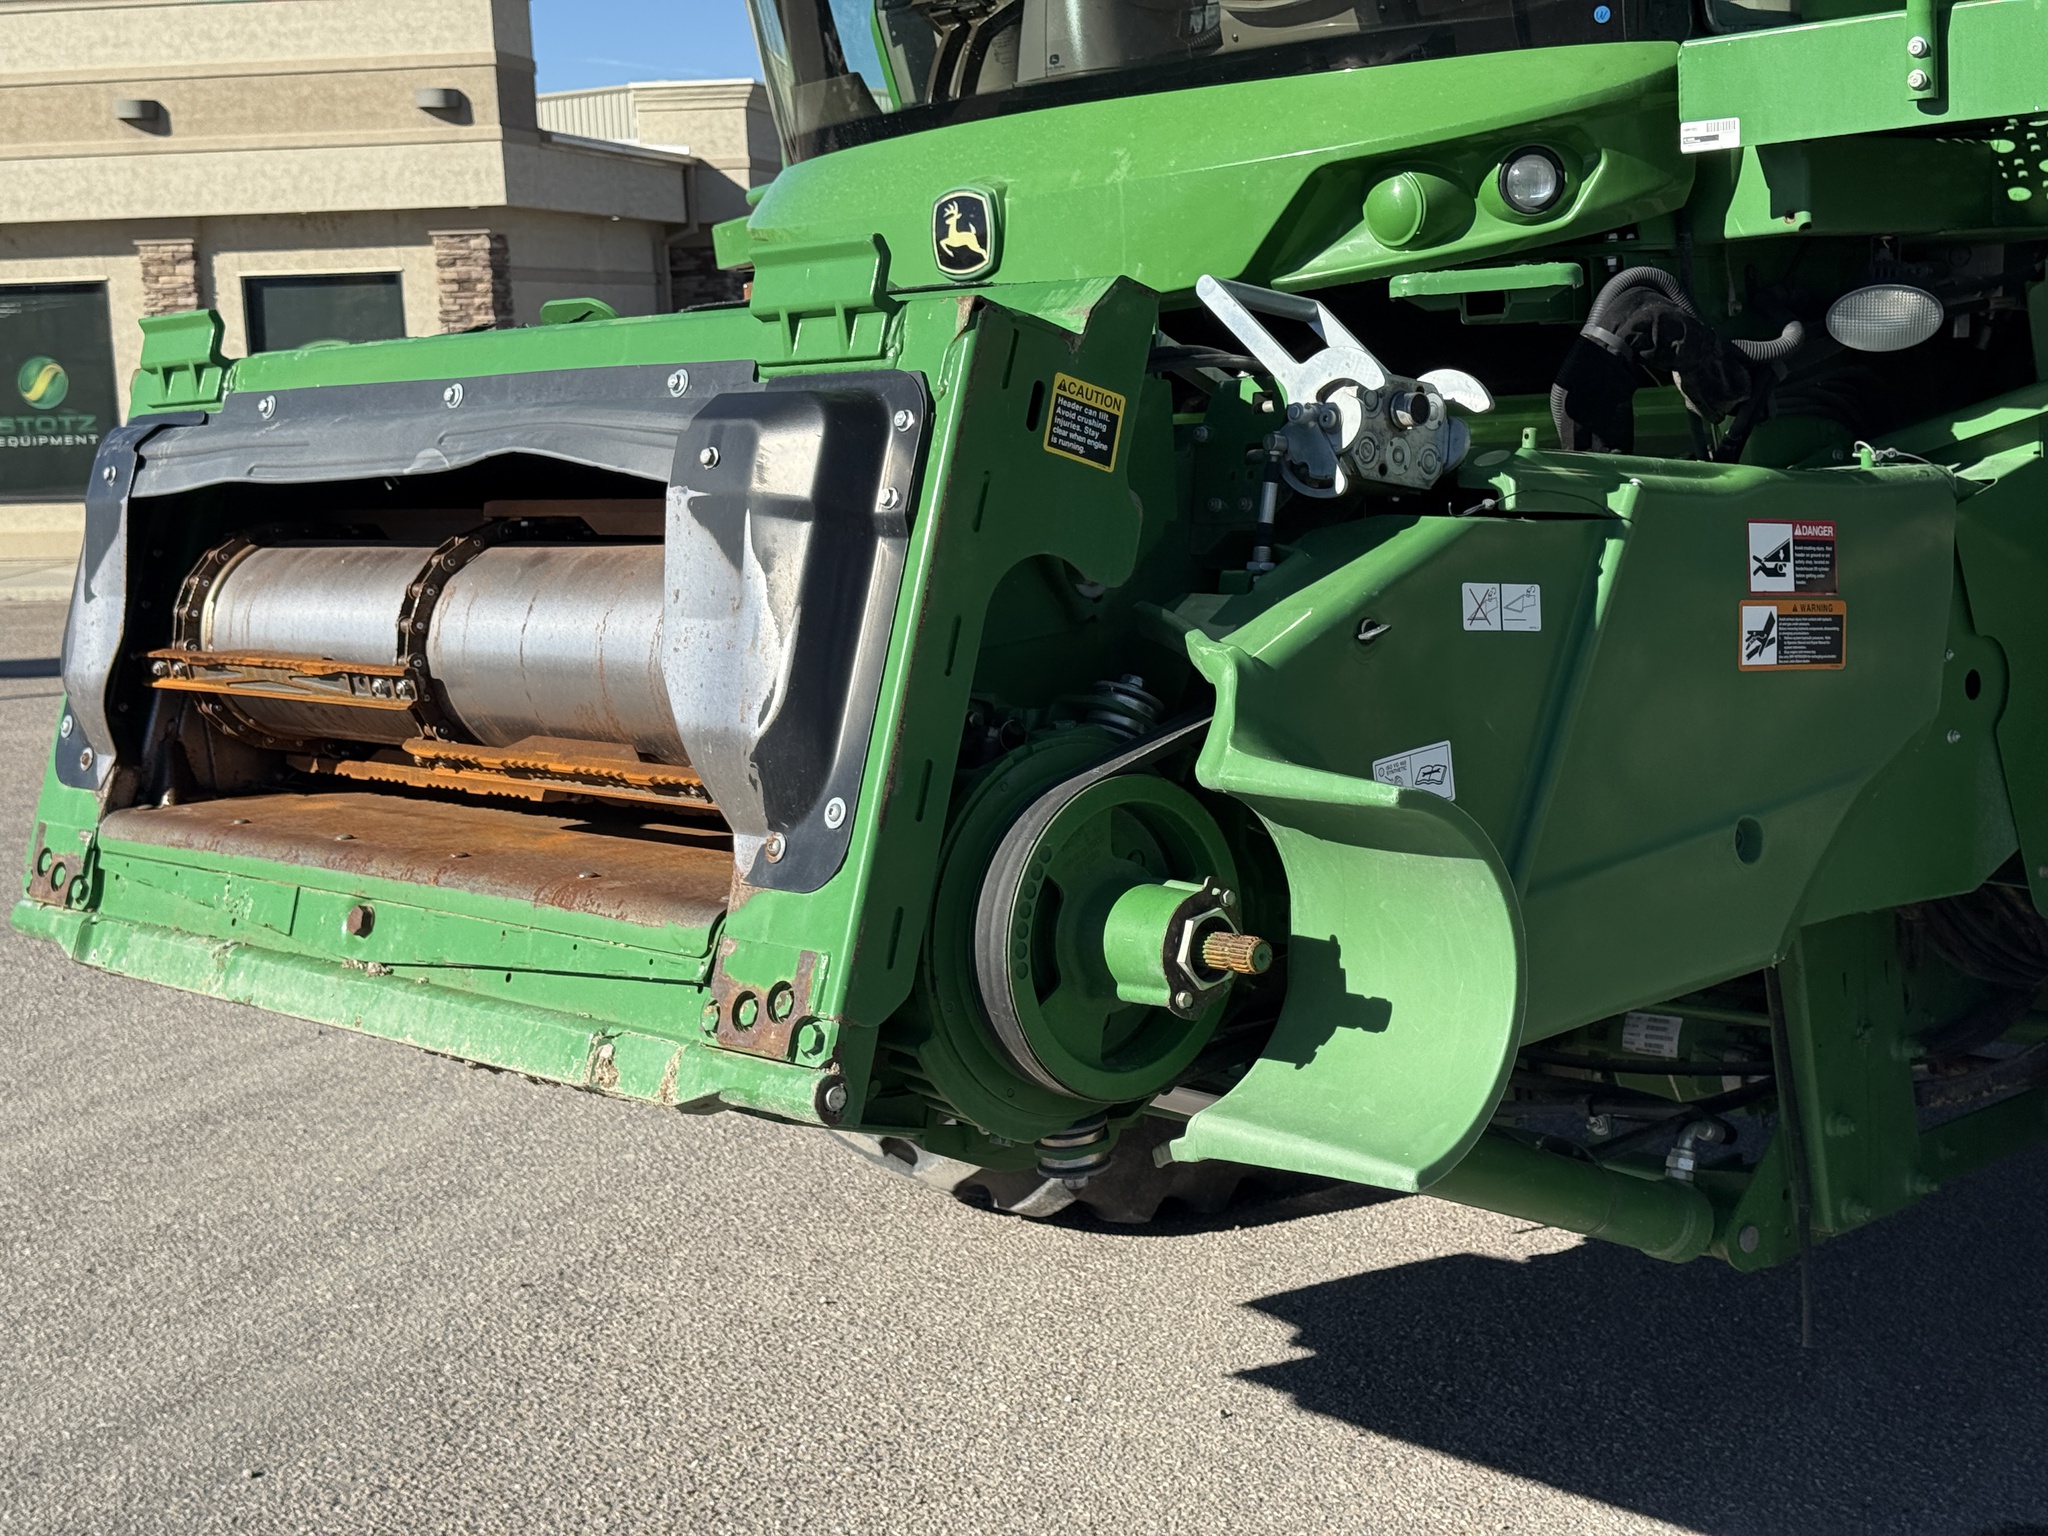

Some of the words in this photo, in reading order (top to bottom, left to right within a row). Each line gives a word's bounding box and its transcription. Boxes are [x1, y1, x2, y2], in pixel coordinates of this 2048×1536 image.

[1058, 396, 1082, 412] Header
[1084, 407, 1097, 418] can
[1068, 382, 1122, 412] CAUTION
[0, 415, 96, 434] STOTZ
[1055, 416, 1082, 432] injuries.
[1084, 427, 1100, 439] Stay
[1056, 406, 1076, 419] Avoid
[1077, 415, 1107, 432] crushing
[1051, 435, 1057, 443] is
[1058, 440, 1086, 454] running.
[1053, 426, 1068, 436] clear
[1069, 433, 1086, 443] when
[1087, 440, 1108, 451] engine
[1802, 526, 1833, 536] DANGER
[1800, 604, 1833, 612] WARNING
